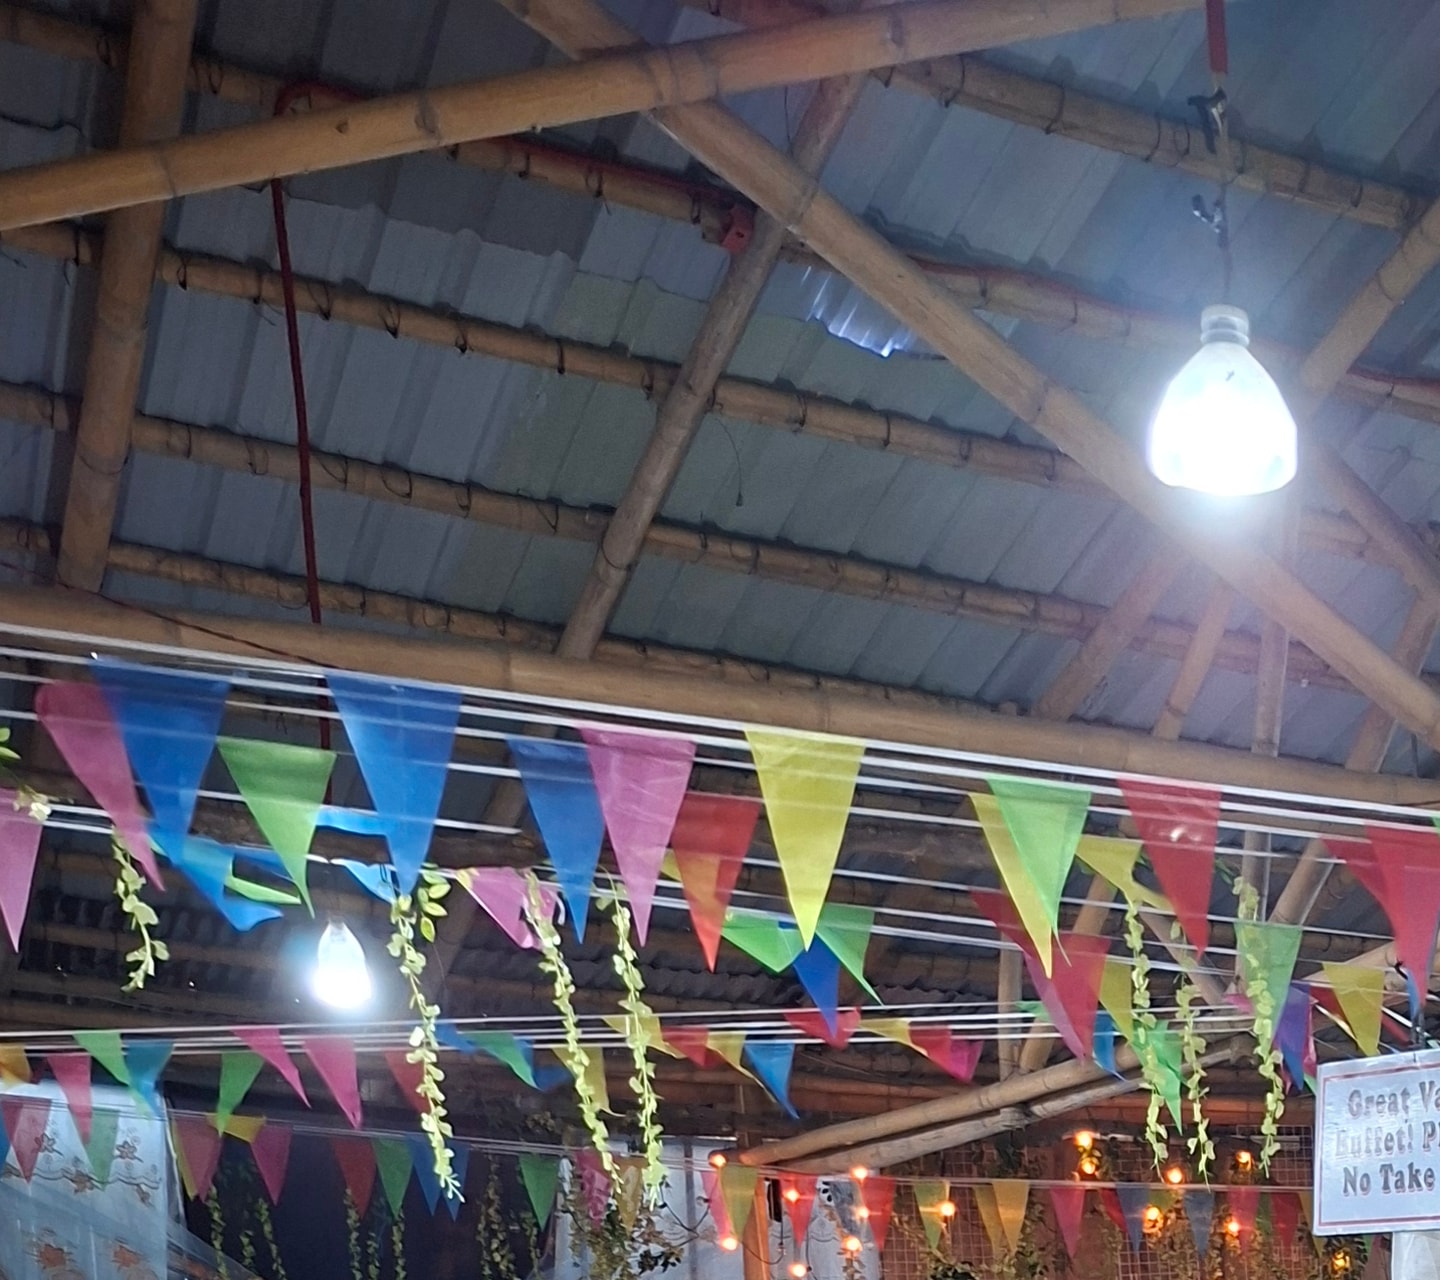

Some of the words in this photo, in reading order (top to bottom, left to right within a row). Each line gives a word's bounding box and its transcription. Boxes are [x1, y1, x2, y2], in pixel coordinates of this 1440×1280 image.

[1347, 1087, 1410, 1118] Great
[1343, 1166, 1371, 1196] No
[1379, 1162, 1436, 1194] Take
